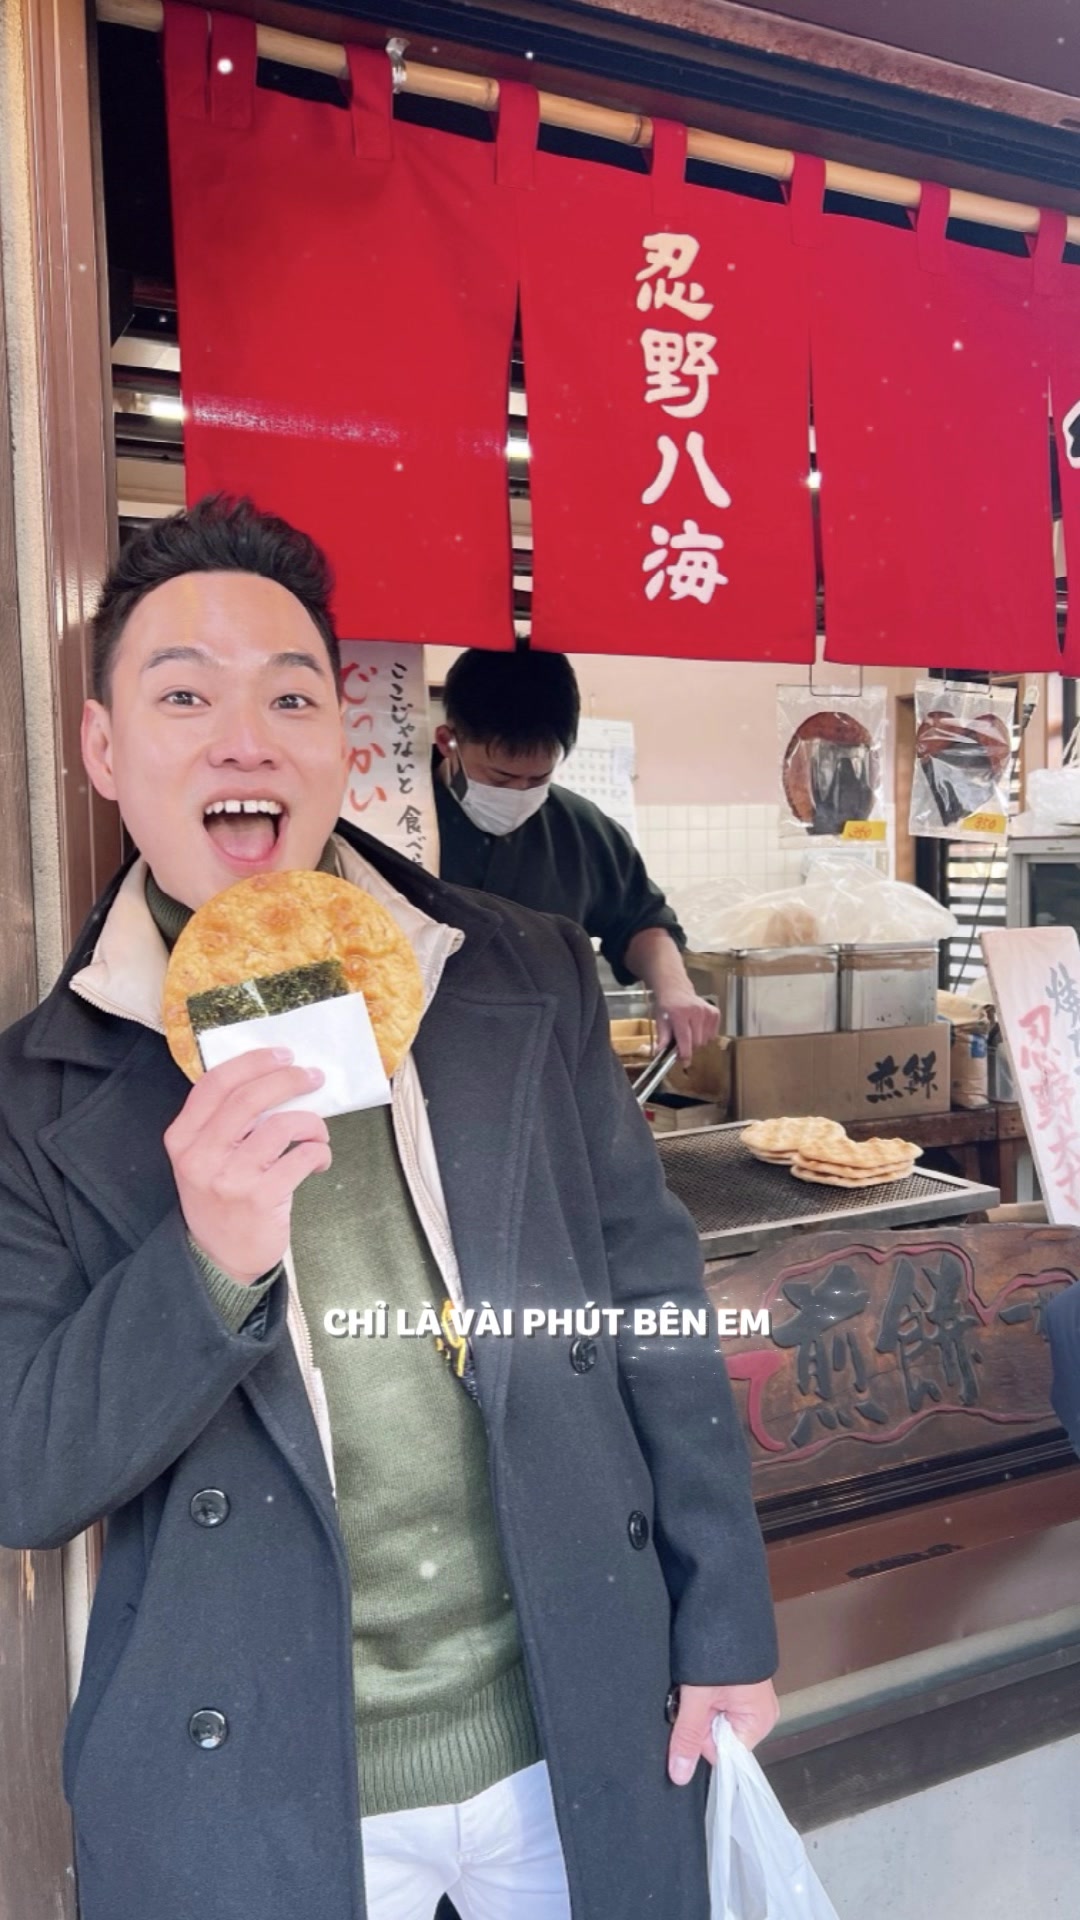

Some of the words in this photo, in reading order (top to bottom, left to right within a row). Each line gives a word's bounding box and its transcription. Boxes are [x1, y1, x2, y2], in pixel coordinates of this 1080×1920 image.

[635, 232, 732, 605] 忍野八海
[340, 662, 387, 812] でっかい
[389, 661, 416, 795] ここじゃないと
[865, 1050, 939, 1104] 煎餅
